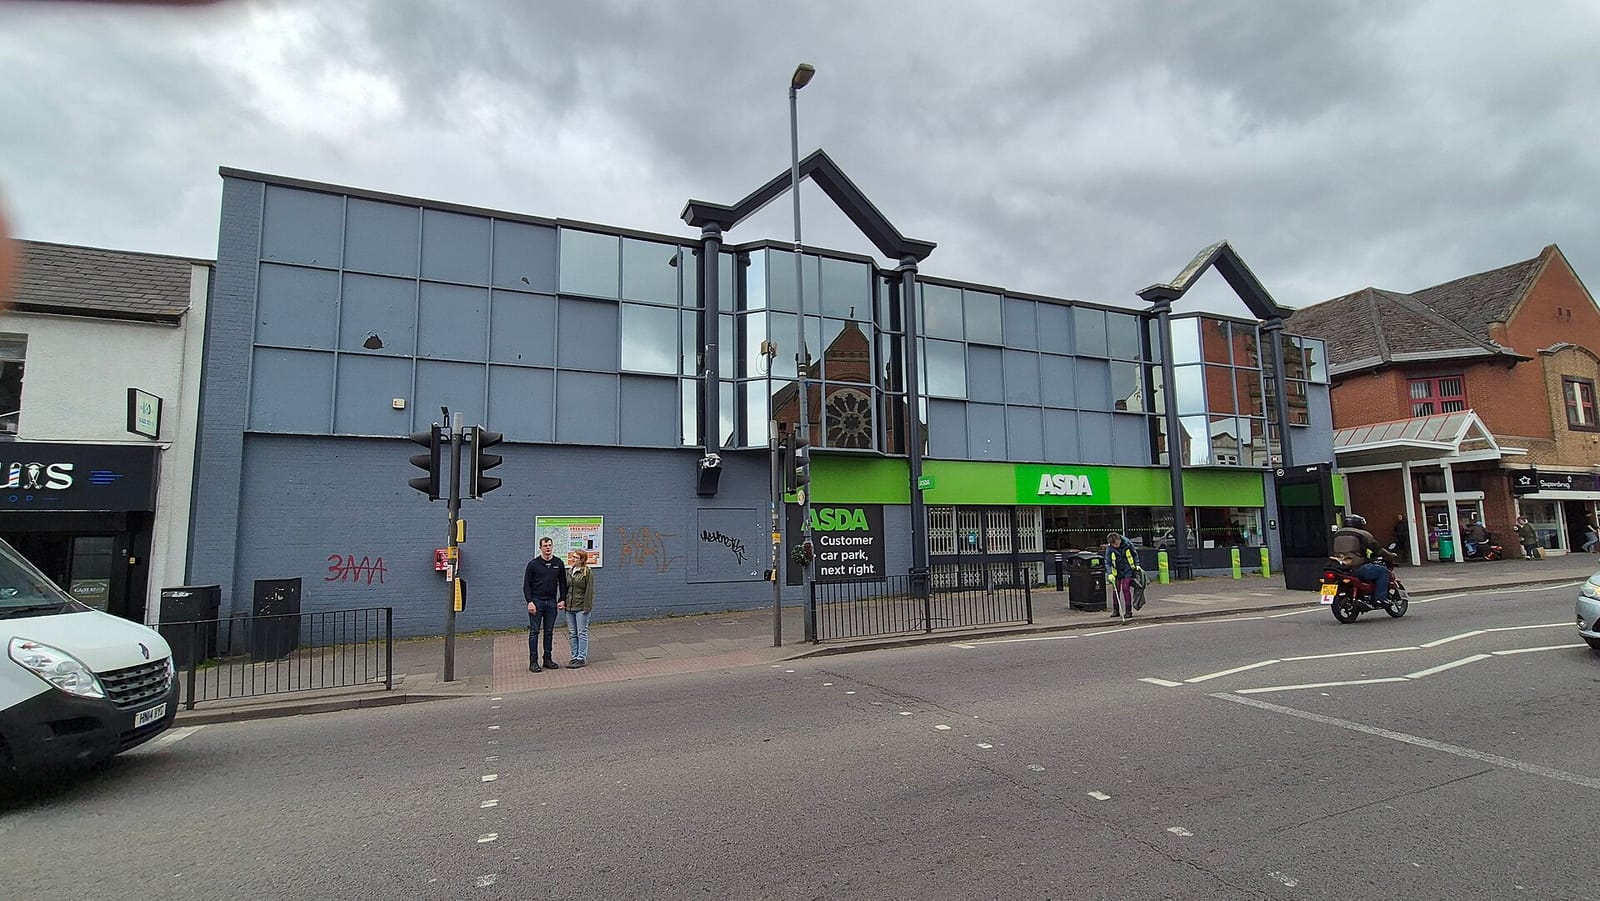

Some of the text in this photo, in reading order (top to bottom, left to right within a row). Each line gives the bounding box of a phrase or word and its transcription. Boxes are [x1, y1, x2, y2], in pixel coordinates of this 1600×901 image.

[1038, 474, 1093, 496] ASDA
[801, 508, 869, 531] ASDA
[820, 535, 873, 546] Customer
[820, 549, 868, 562] car park,
[821, 565, 845, 575] next
